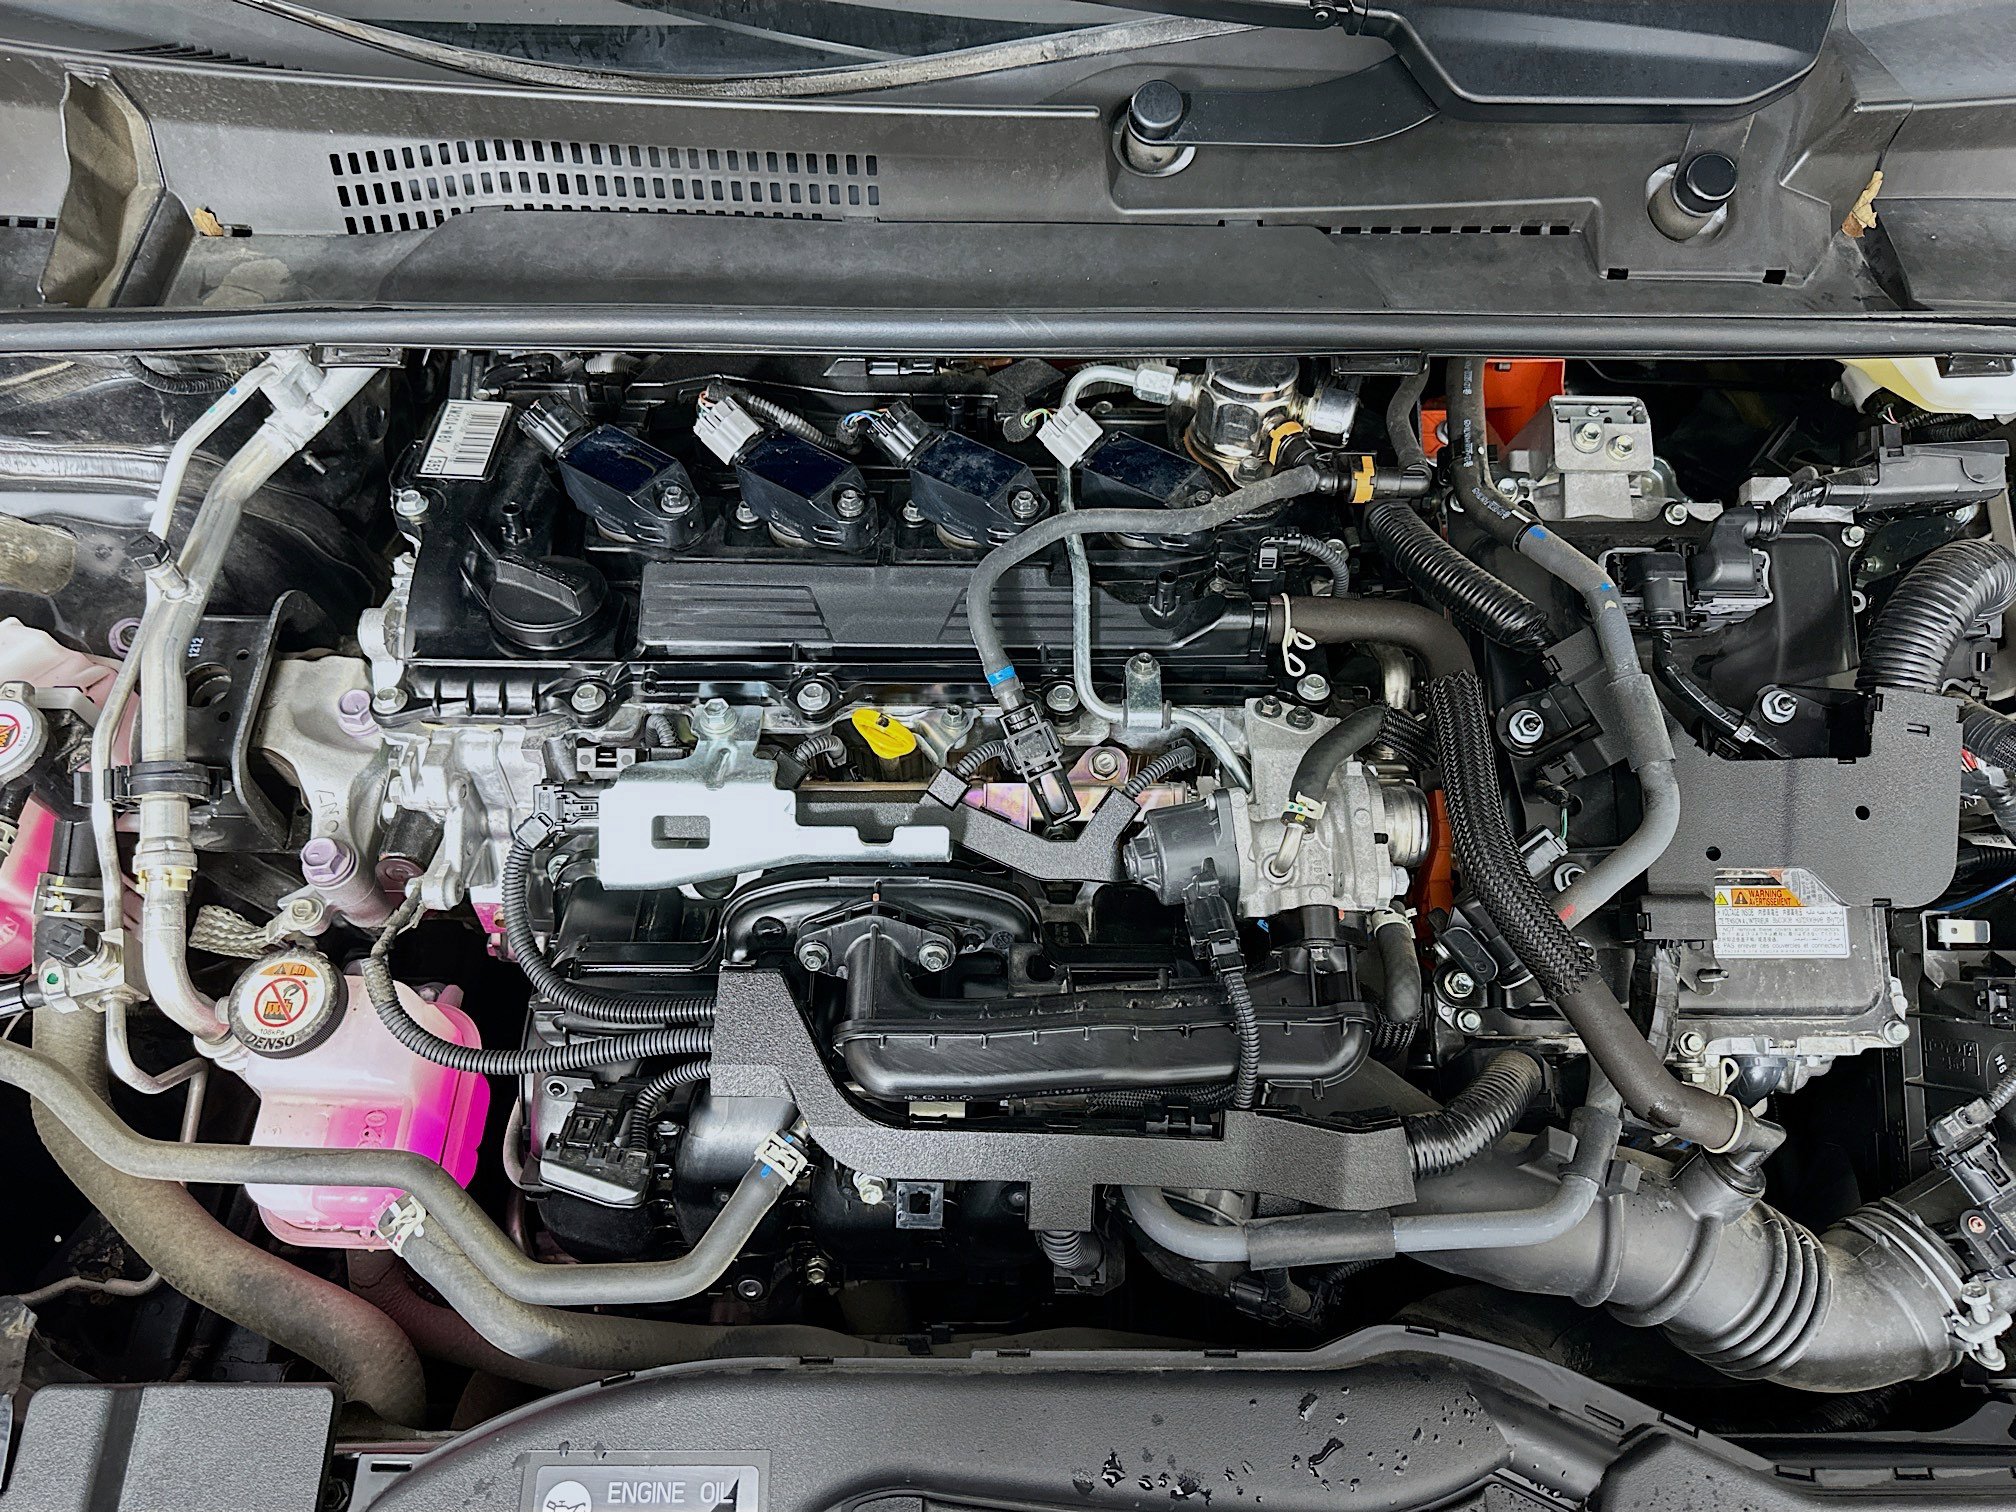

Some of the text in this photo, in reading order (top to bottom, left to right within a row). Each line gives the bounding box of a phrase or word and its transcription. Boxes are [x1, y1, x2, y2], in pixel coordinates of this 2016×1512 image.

[1749, 889, 1782, 898] WARNING
[1749, 898, 1791, 906] AVERTISSEMENT
[245, 1033, 296, 1050] DENSO
[607, 1481, 734, 1504] ENGINE OIL
